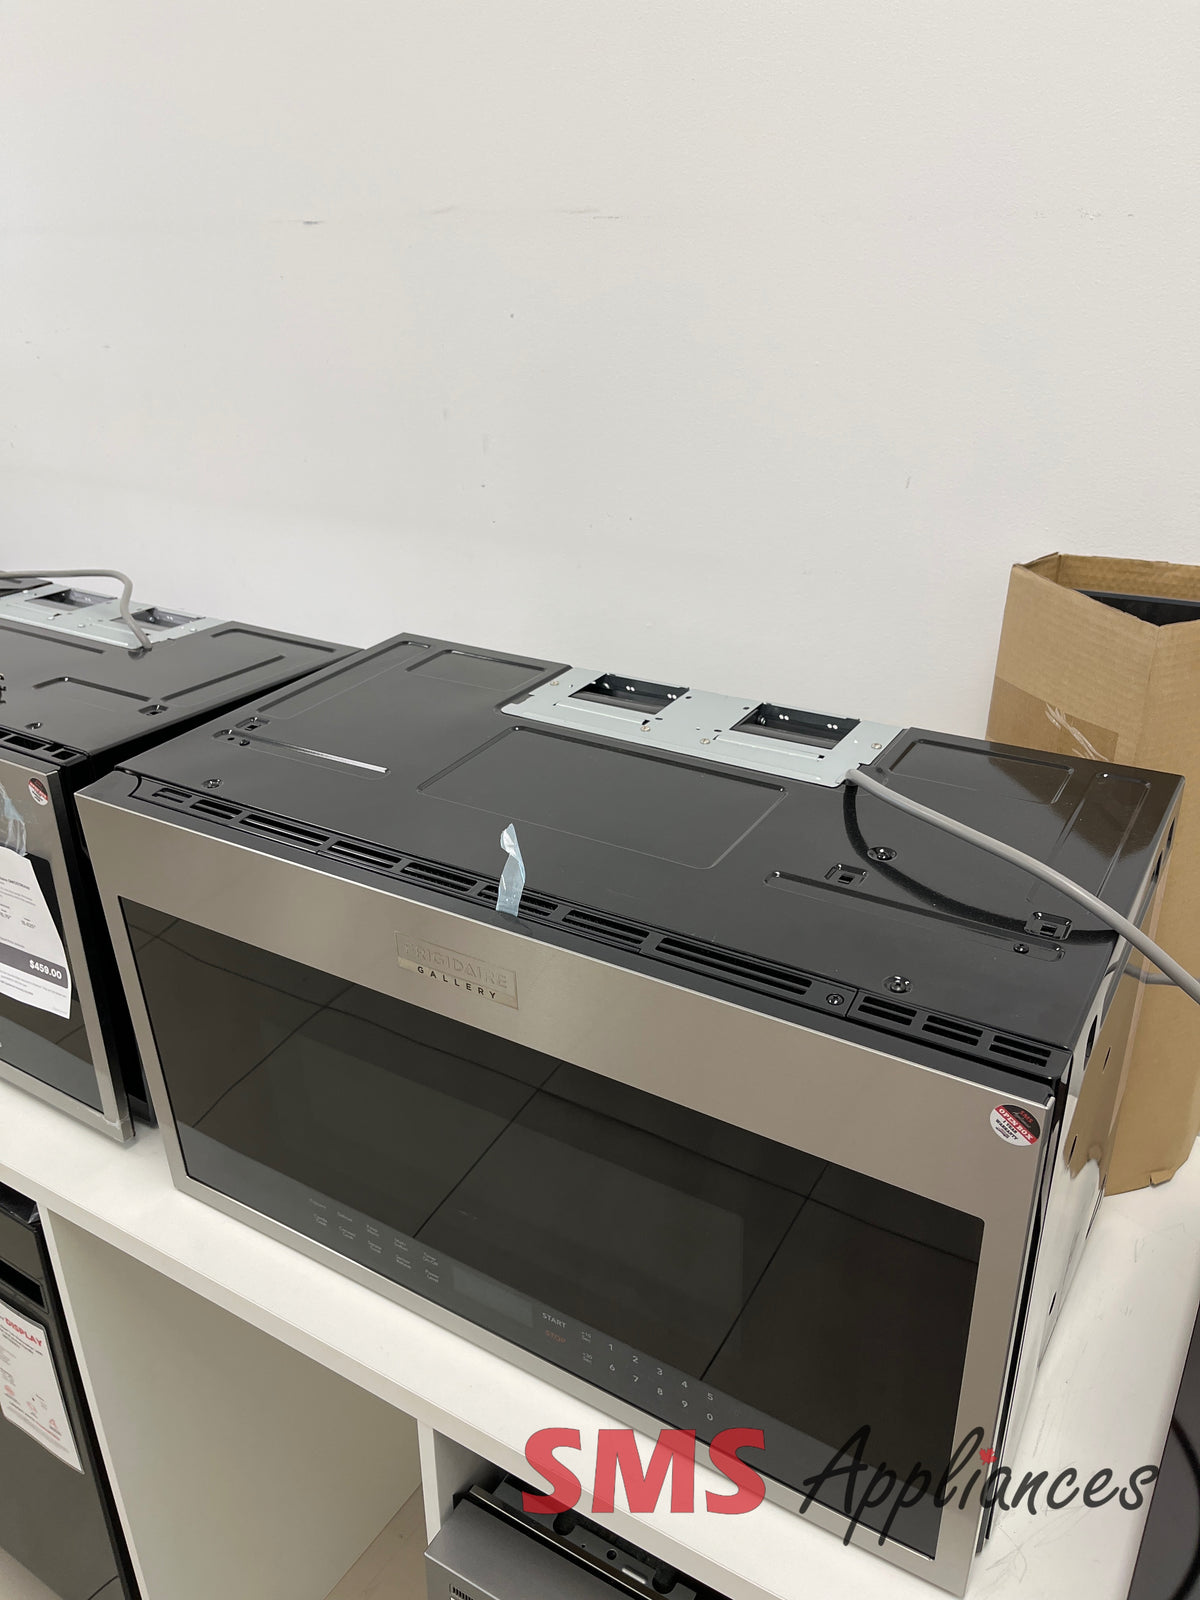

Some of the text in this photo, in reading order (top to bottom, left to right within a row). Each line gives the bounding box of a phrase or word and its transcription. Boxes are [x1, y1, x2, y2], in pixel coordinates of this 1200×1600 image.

[29, 959, 62, 980] $459.00
[417, 966, 496, 999] GALLERY
[999, 1108, 1019, 1127] OPEN
[1018, 1125, 1034, 1141] BOX
[542, 1312, 567, 1329] START
[5, 1317, 43, 1347] DISPLAY
[632, 1355, 639, 1364] 2
[609, 1364, 616, 1372] 6
[656, 1367, 663, 1376] 3
[632, 1375, 639, 1383] 7
[681, 1380, 688, 1389] 4
[657, 1387, 664, 1396] 8
[707, 1392, 714, 1401] 5
[681, 1400, 688, 1409] 9
[706, 1412, 714, 1421] 0
